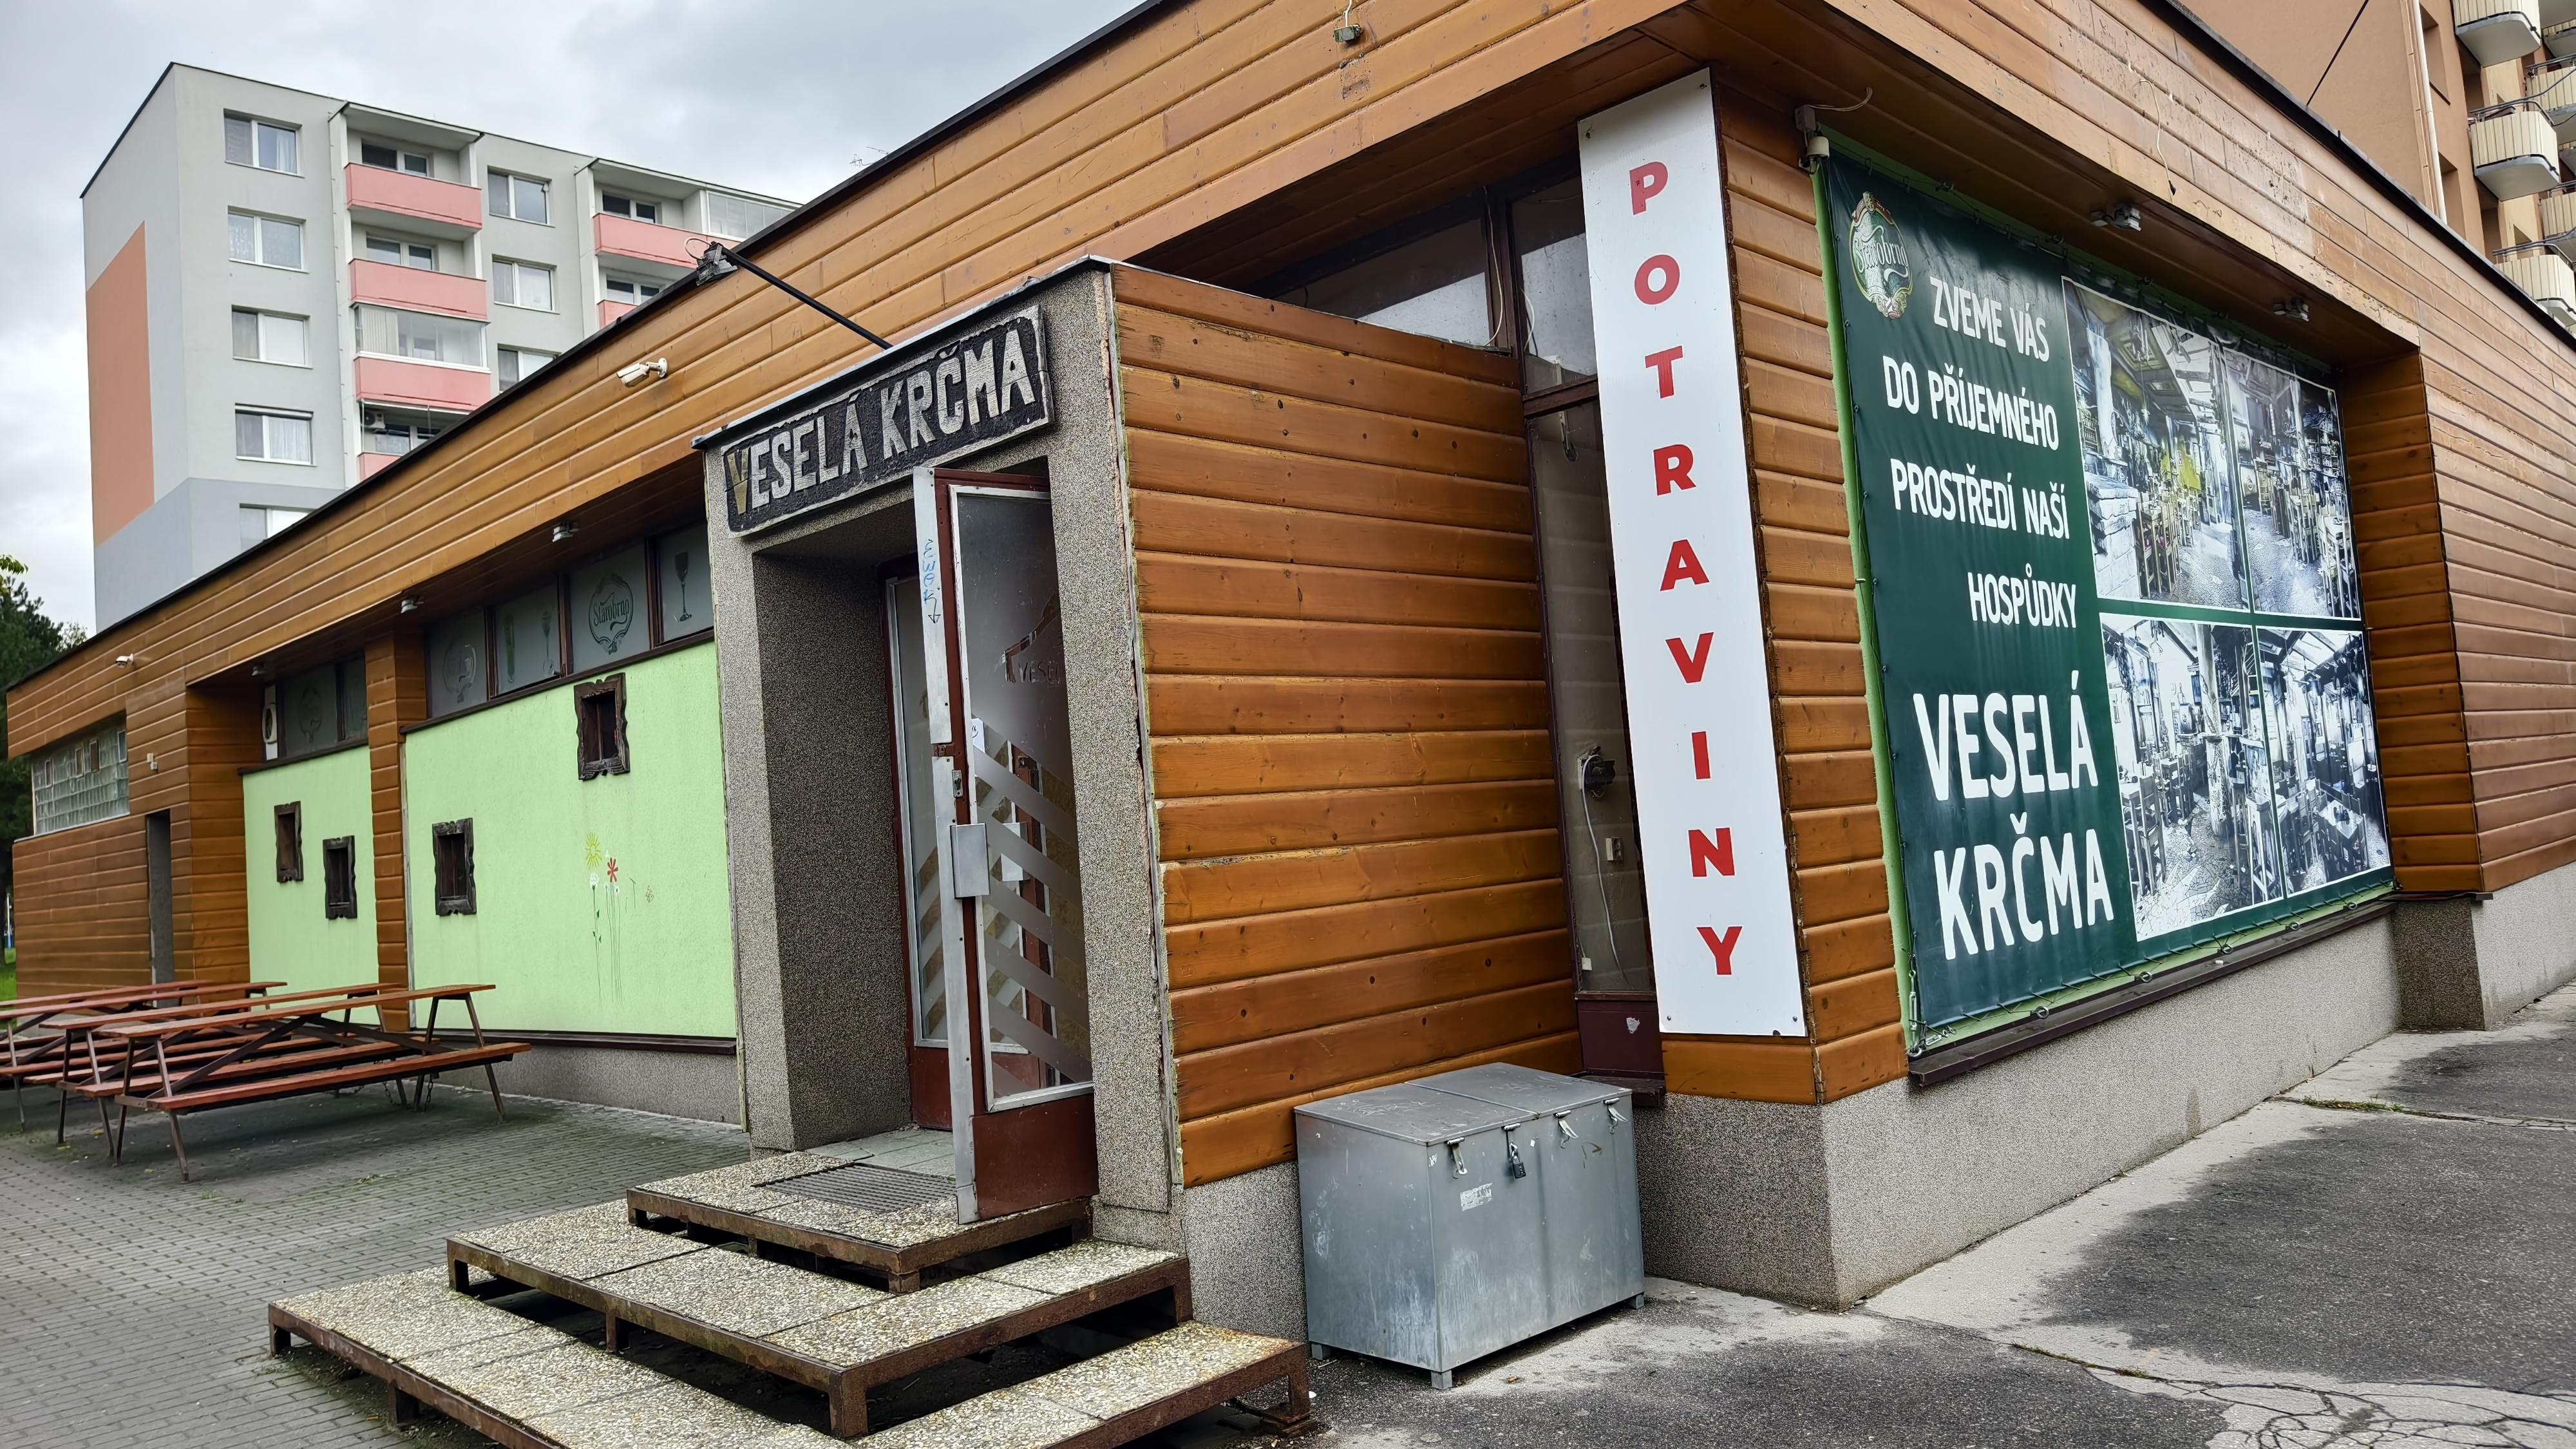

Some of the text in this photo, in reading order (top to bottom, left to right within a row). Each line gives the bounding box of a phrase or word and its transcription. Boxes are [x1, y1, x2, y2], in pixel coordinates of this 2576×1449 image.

[1853, 225, 1909, 281] Starobrno
[1929, 276, 2050, 363] ZVEME VÁS
[726, 329, 1036, 515] VESELÁ KRČMA
[1882, 355, 2060, 451] DO PŘÍJEMNÉHO
[1889, 458, 2070, 540] PROSTŘEDÍ NAŠÍ
[592, 592, 630, 631] Starobrno
[1629, 161, 1743, 976] POTRAVINY
[1967, 562, 2077, 629] HOSPŮDKY
[1018, 660, 1063, 683] VESEL
[1912, 670, 2099, 801] VESELÁ
[1933, 811, 2115, 961] KRČMA
